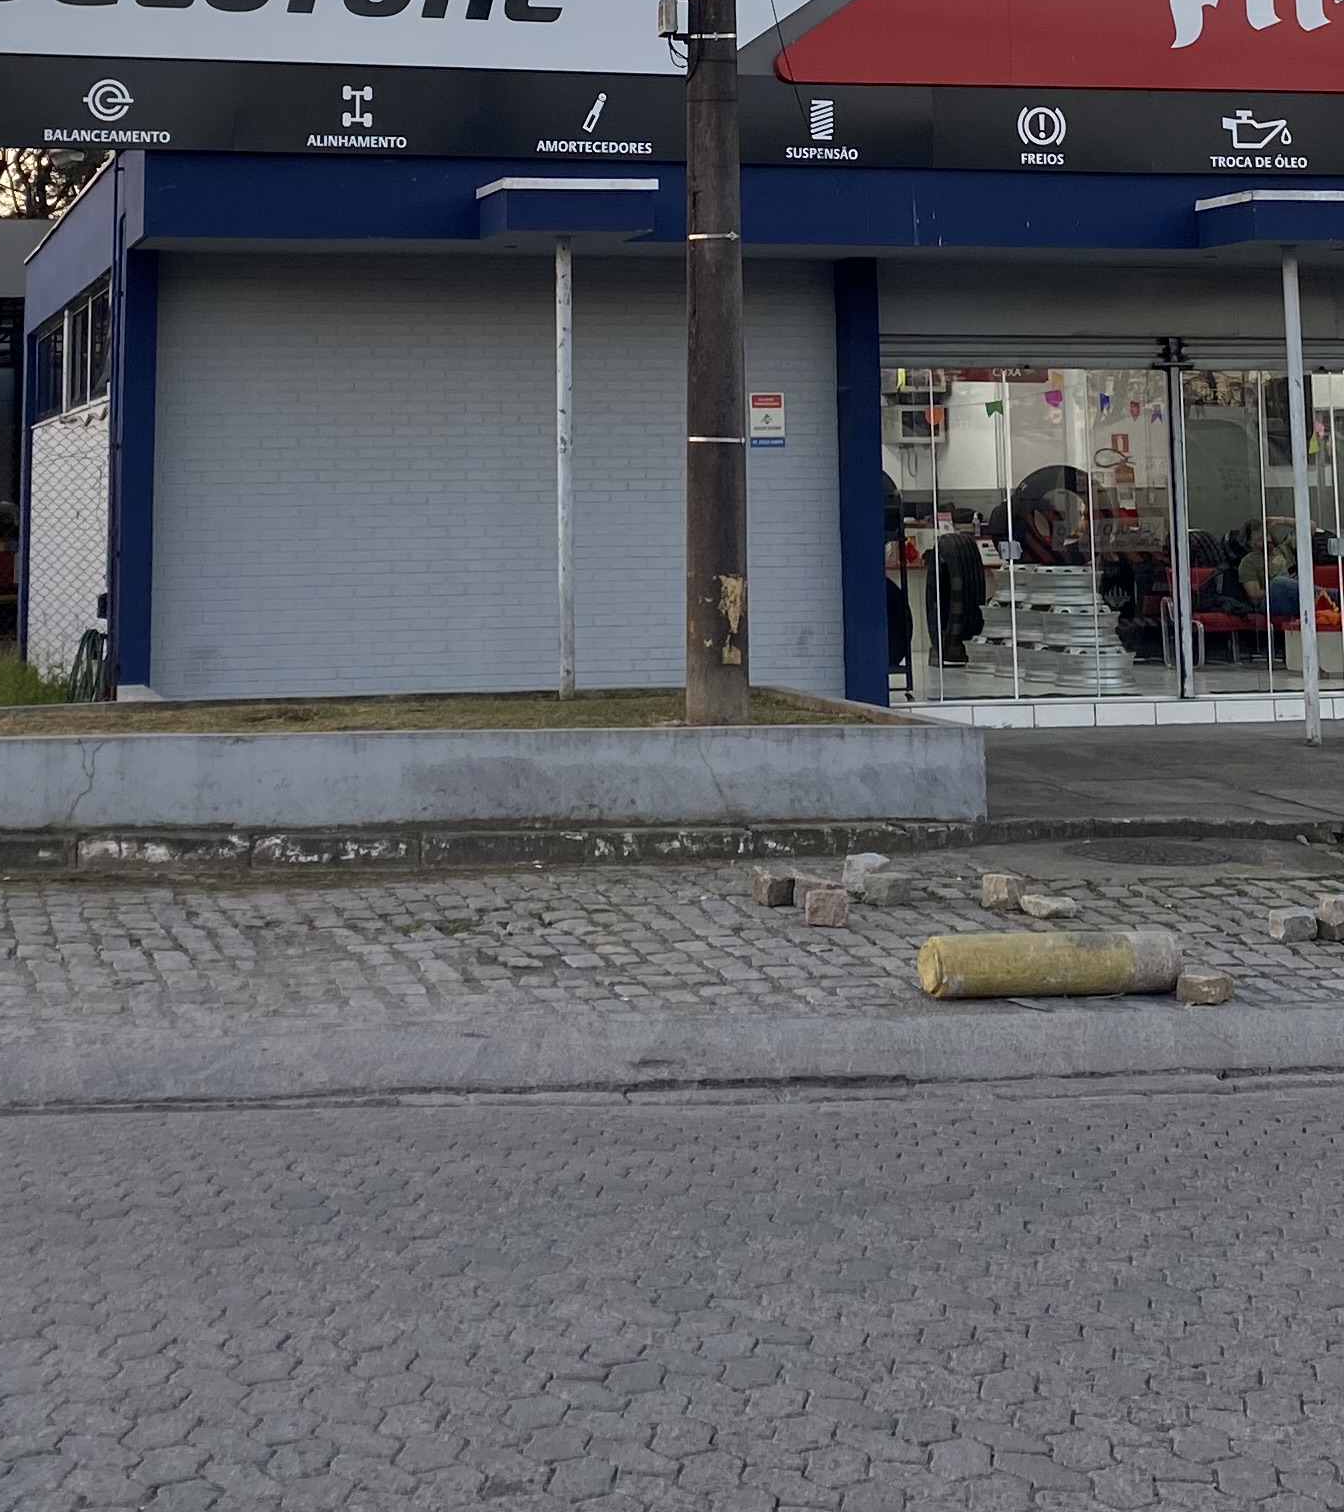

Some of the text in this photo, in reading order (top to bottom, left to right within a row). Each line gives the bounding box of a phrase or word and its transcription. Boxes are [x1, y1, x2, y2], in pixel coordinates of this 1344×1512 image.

[43, 128, 171, 144] BALANCEAMENTO
[306, 134, 407, 149] ALINHAMENTO
[536, 140, 652, 155] AMORTECEDORES
[785, 146, 859, 161] SUSPENSÃO
[1020, 153, 1065, 166] FREIOS
[1209, 153, 1308, 169] TROCA DE ÓLEO
